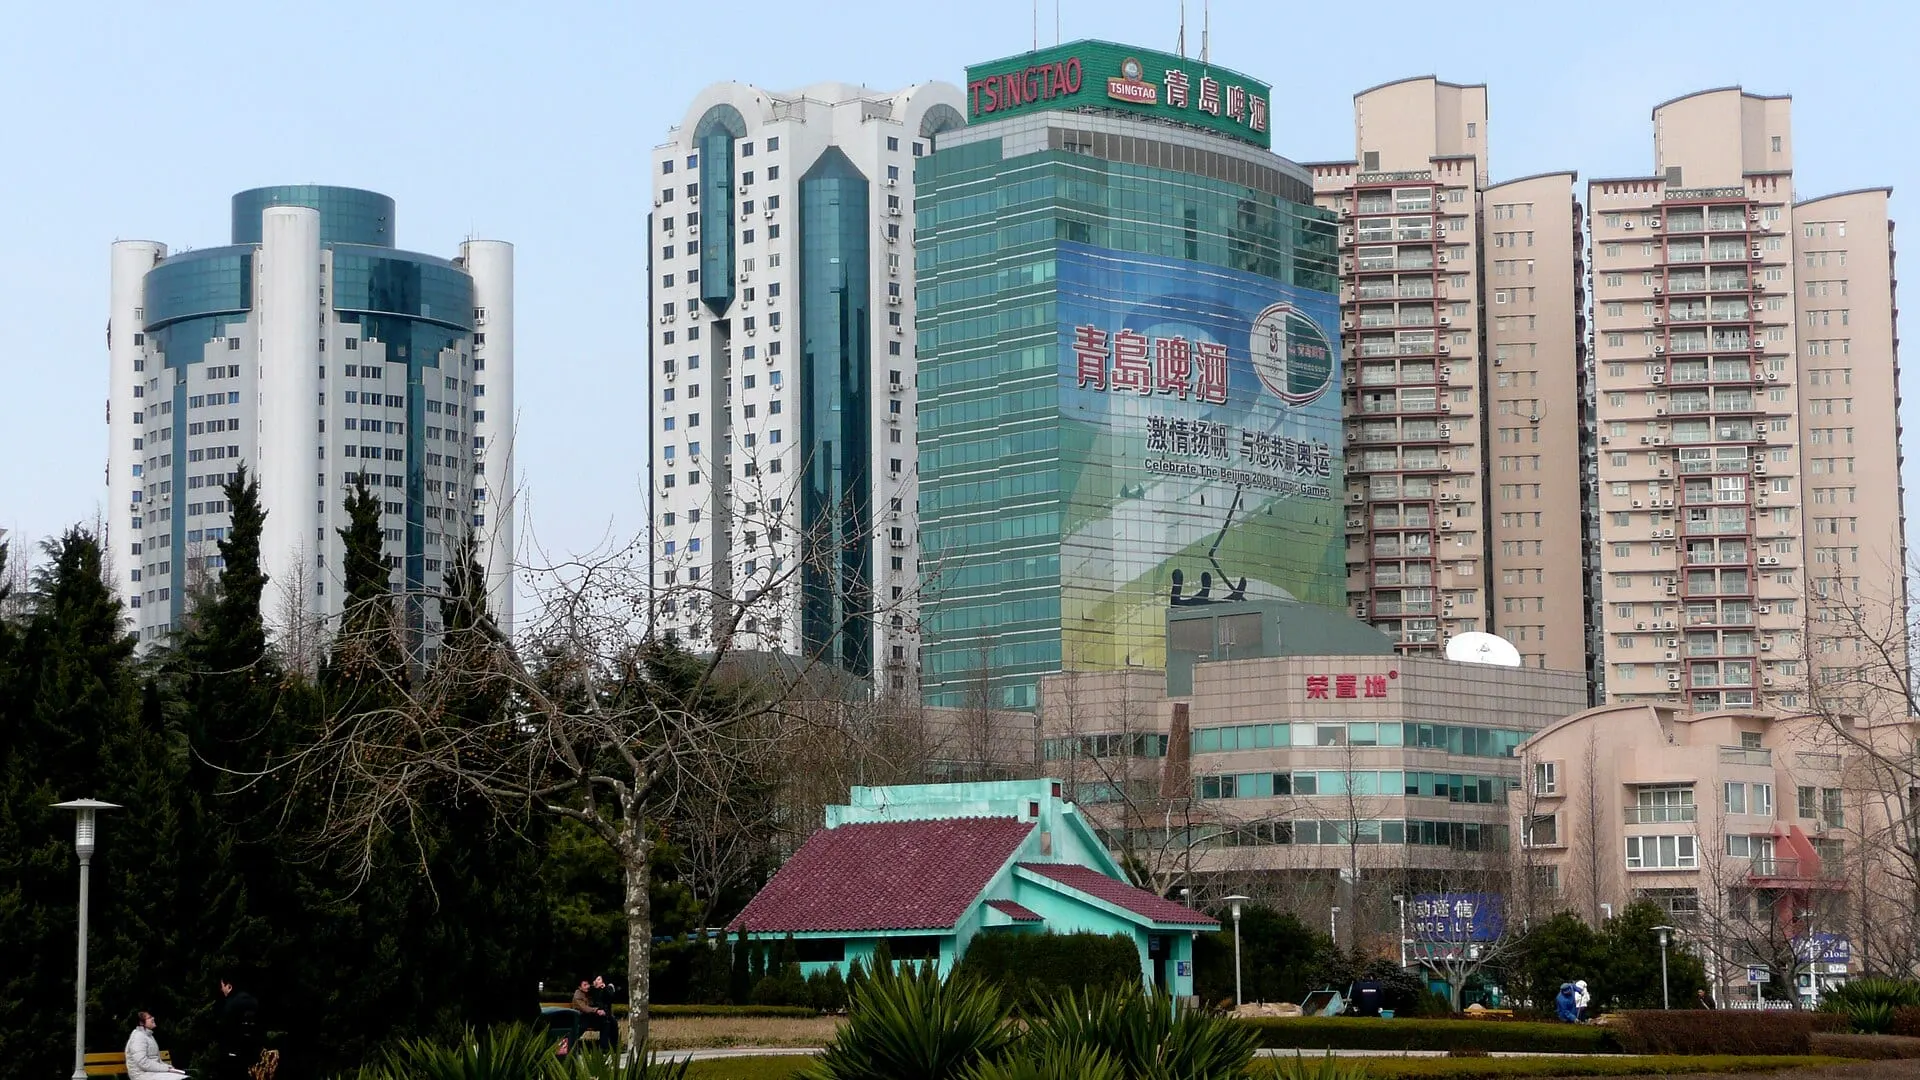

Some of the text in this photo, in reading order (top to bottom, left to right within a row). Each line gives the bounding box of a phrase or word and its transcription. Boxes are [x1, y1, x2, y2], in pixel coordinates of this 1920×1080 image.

[968, 57, 1083, 116] TSINGTAO
[1110, 82, 1156, 100] TSINGTAO
[1146, 415, 1230, 460] 激情扬帆
[1144, 459, 1197, 475] Celebrate
[1200, 465, 1218, 477] The
[1221, 468, 1250, 484] Beijing
[1252, 472, 1271, 485] 2008
[1301, 484, 1331, 497] Games
